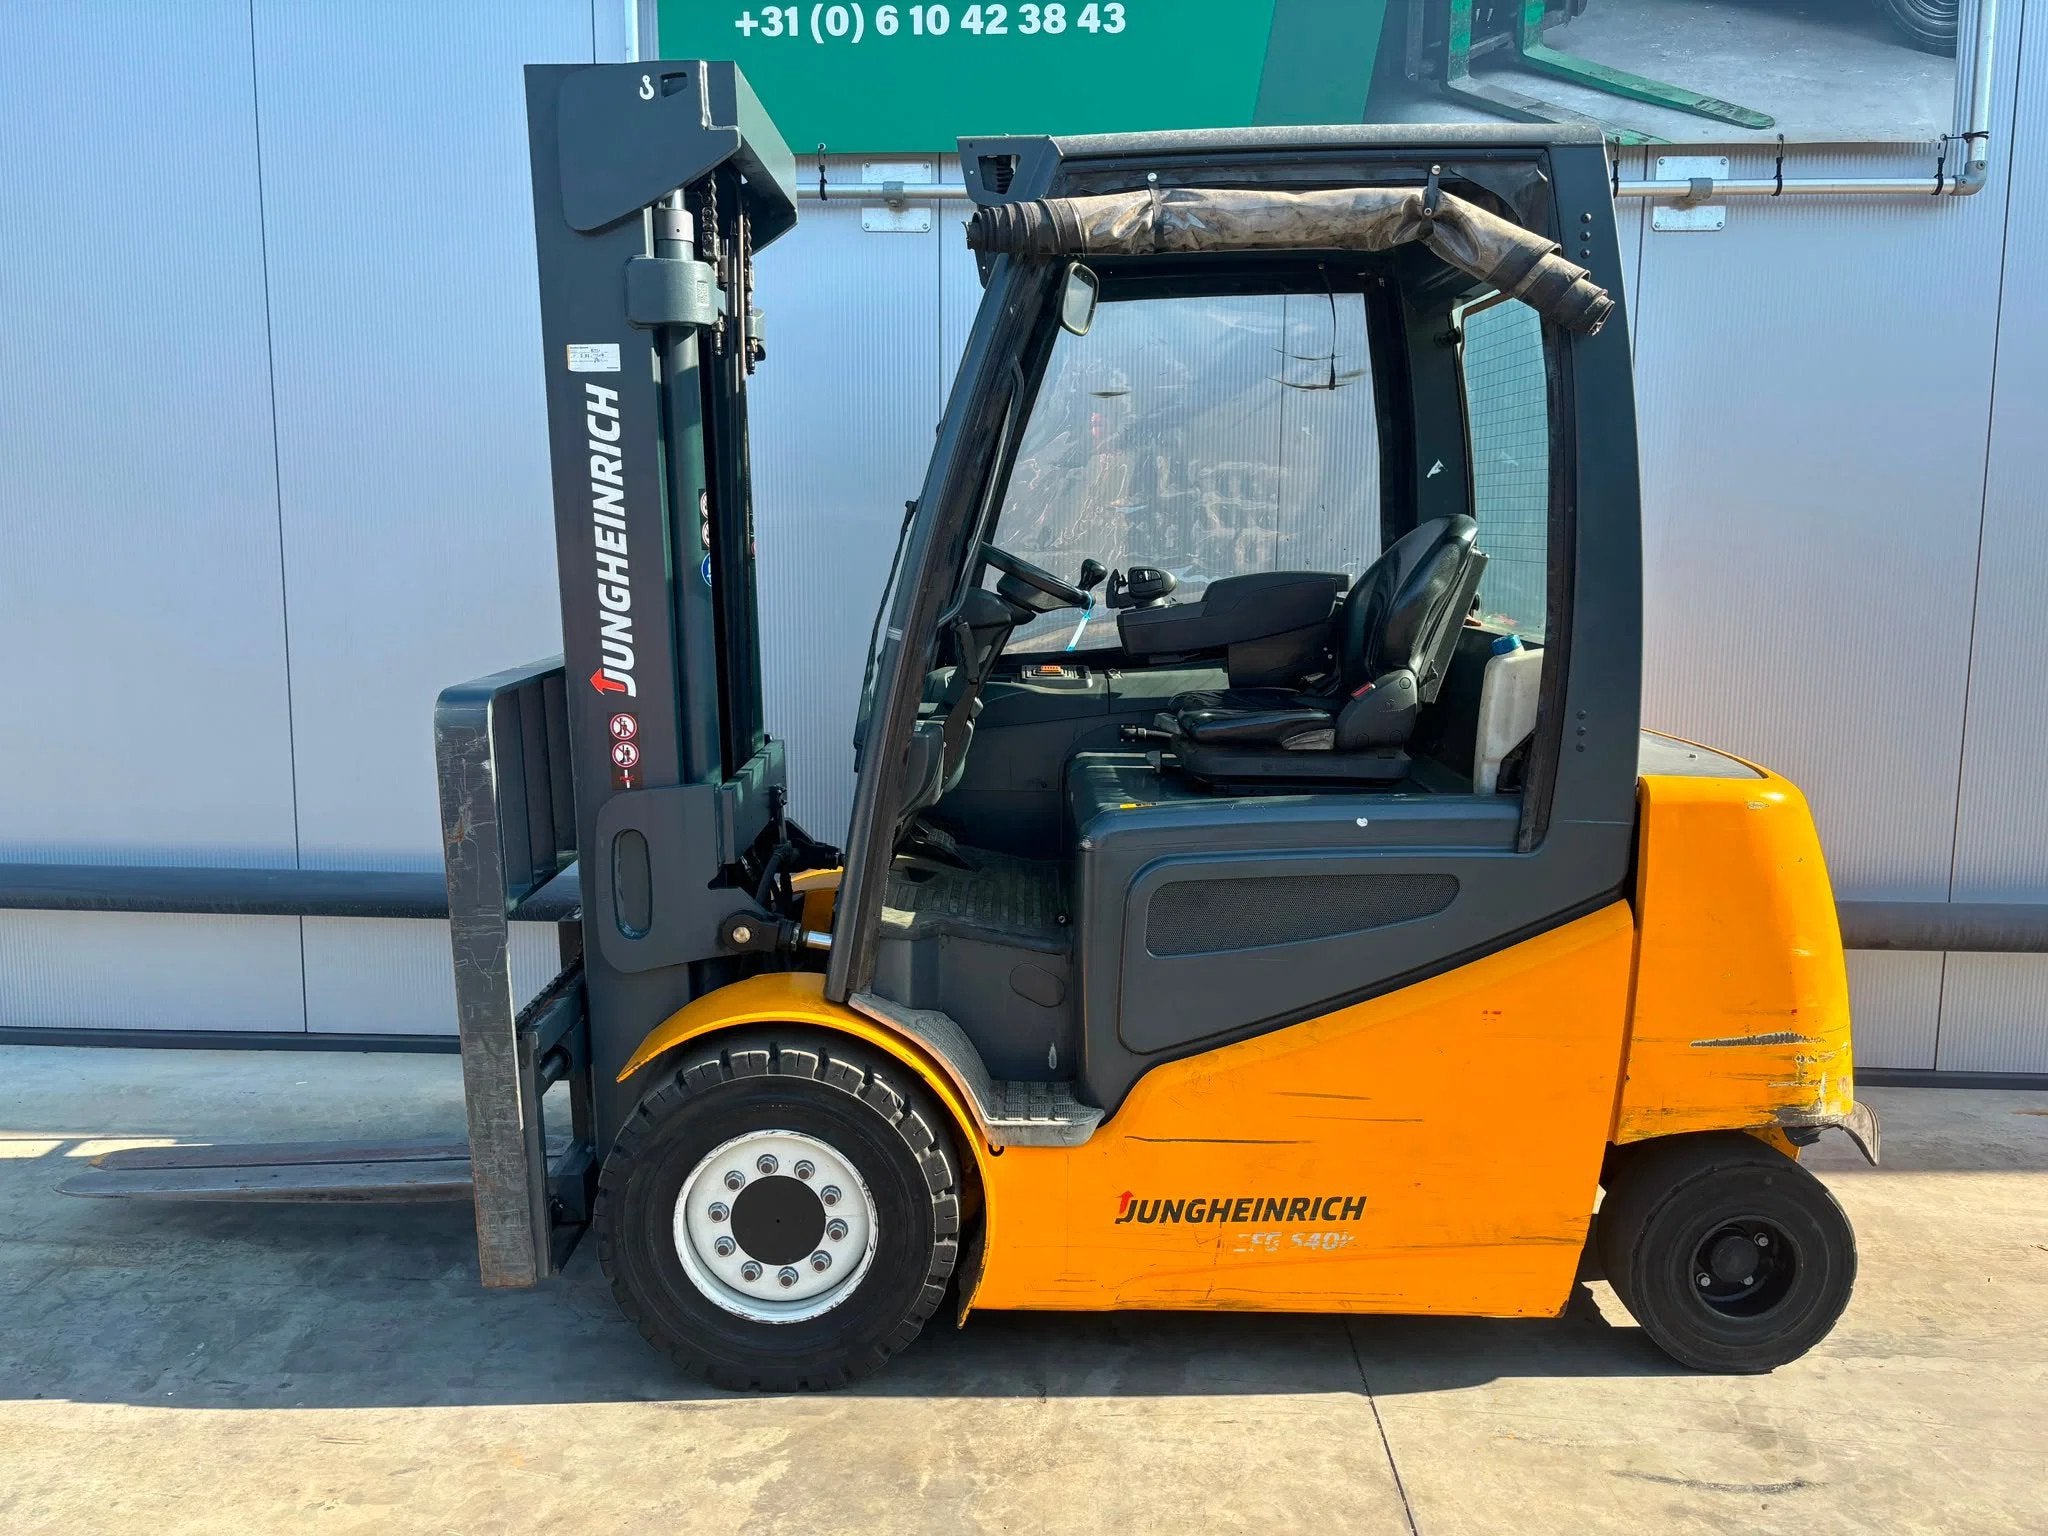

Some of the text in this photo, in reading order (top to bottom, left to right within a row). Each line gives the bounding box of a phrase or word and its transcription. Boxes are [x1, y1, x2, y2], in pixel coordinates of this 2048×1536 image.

[735, 2, 1126, 44] +31 (0) 6 10 42 38 43
[585, 382, 637, 698] JUNGHEINRICH
[1115, 1194, 1367, 1225] JUNGHEINRICH
